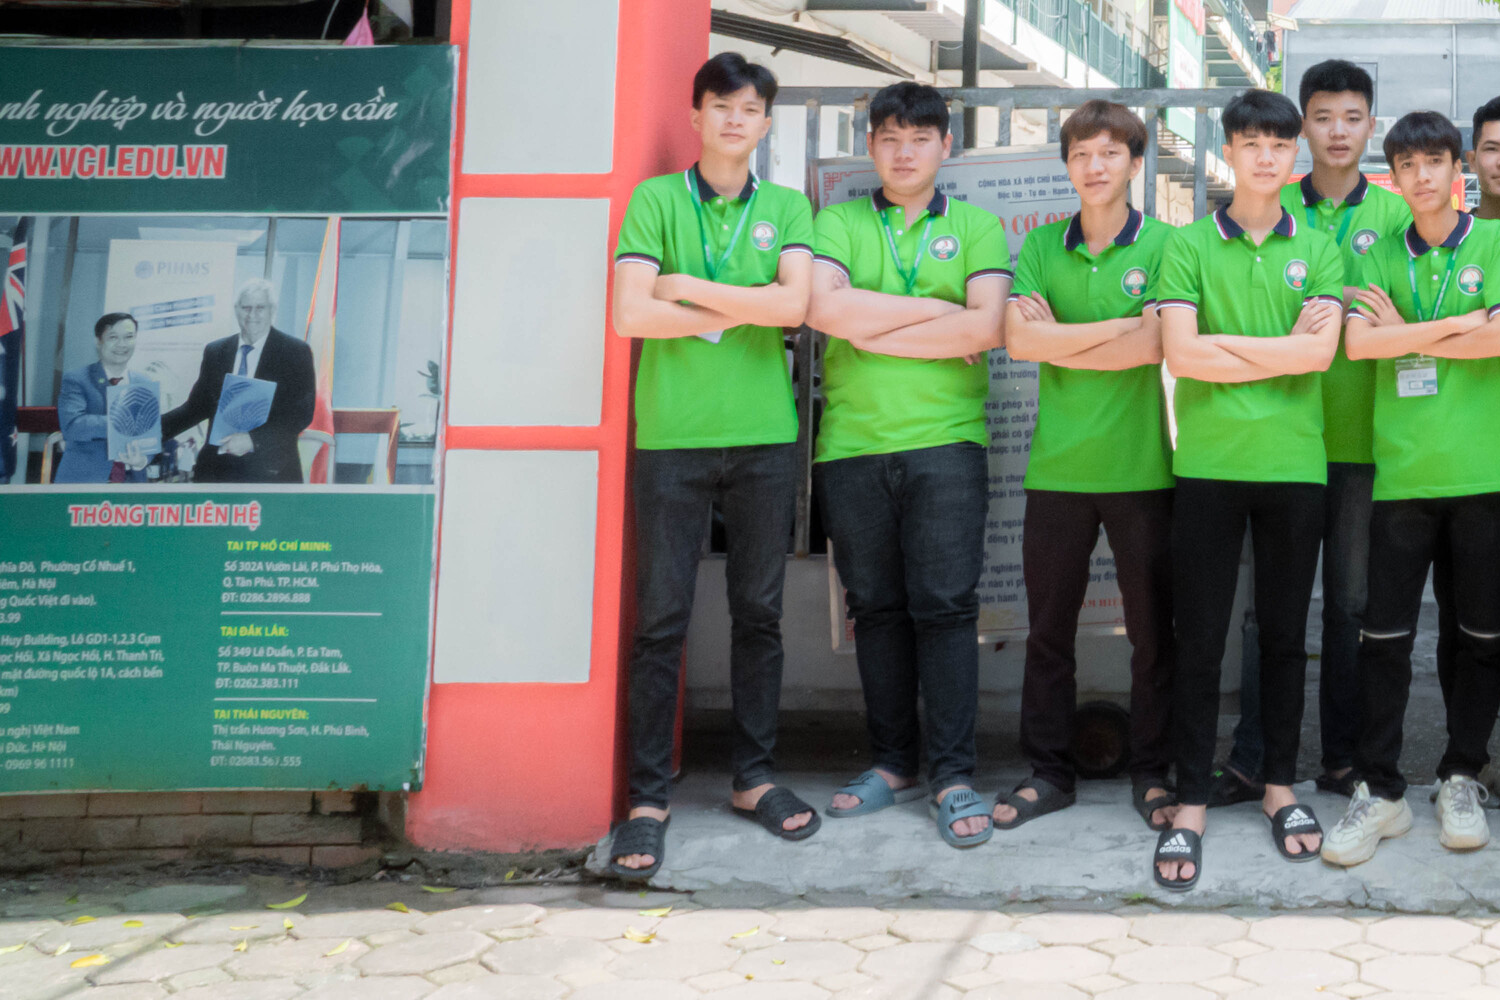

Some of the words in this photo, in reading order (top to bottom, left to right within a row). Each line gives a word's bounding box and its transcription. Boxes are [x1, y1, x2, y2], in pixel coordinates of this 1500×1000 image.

[44, 89, 146, 137] nghiệp
[150, 91, 188, 121] và
[194, 90, 282, 138] người
[282, 90, 338, 128] học
[341, 86, 399, 121] cần
[70, 501, 144, 526] THÔNG
[147, 504, 181, 526] TIN
[184, 501, 229, 526] LIÊN
[232, 501, 261, 531] HỆ
[1284, 817, 1316, 829] adidas
[1159, 845, 1192, 854] adidas
